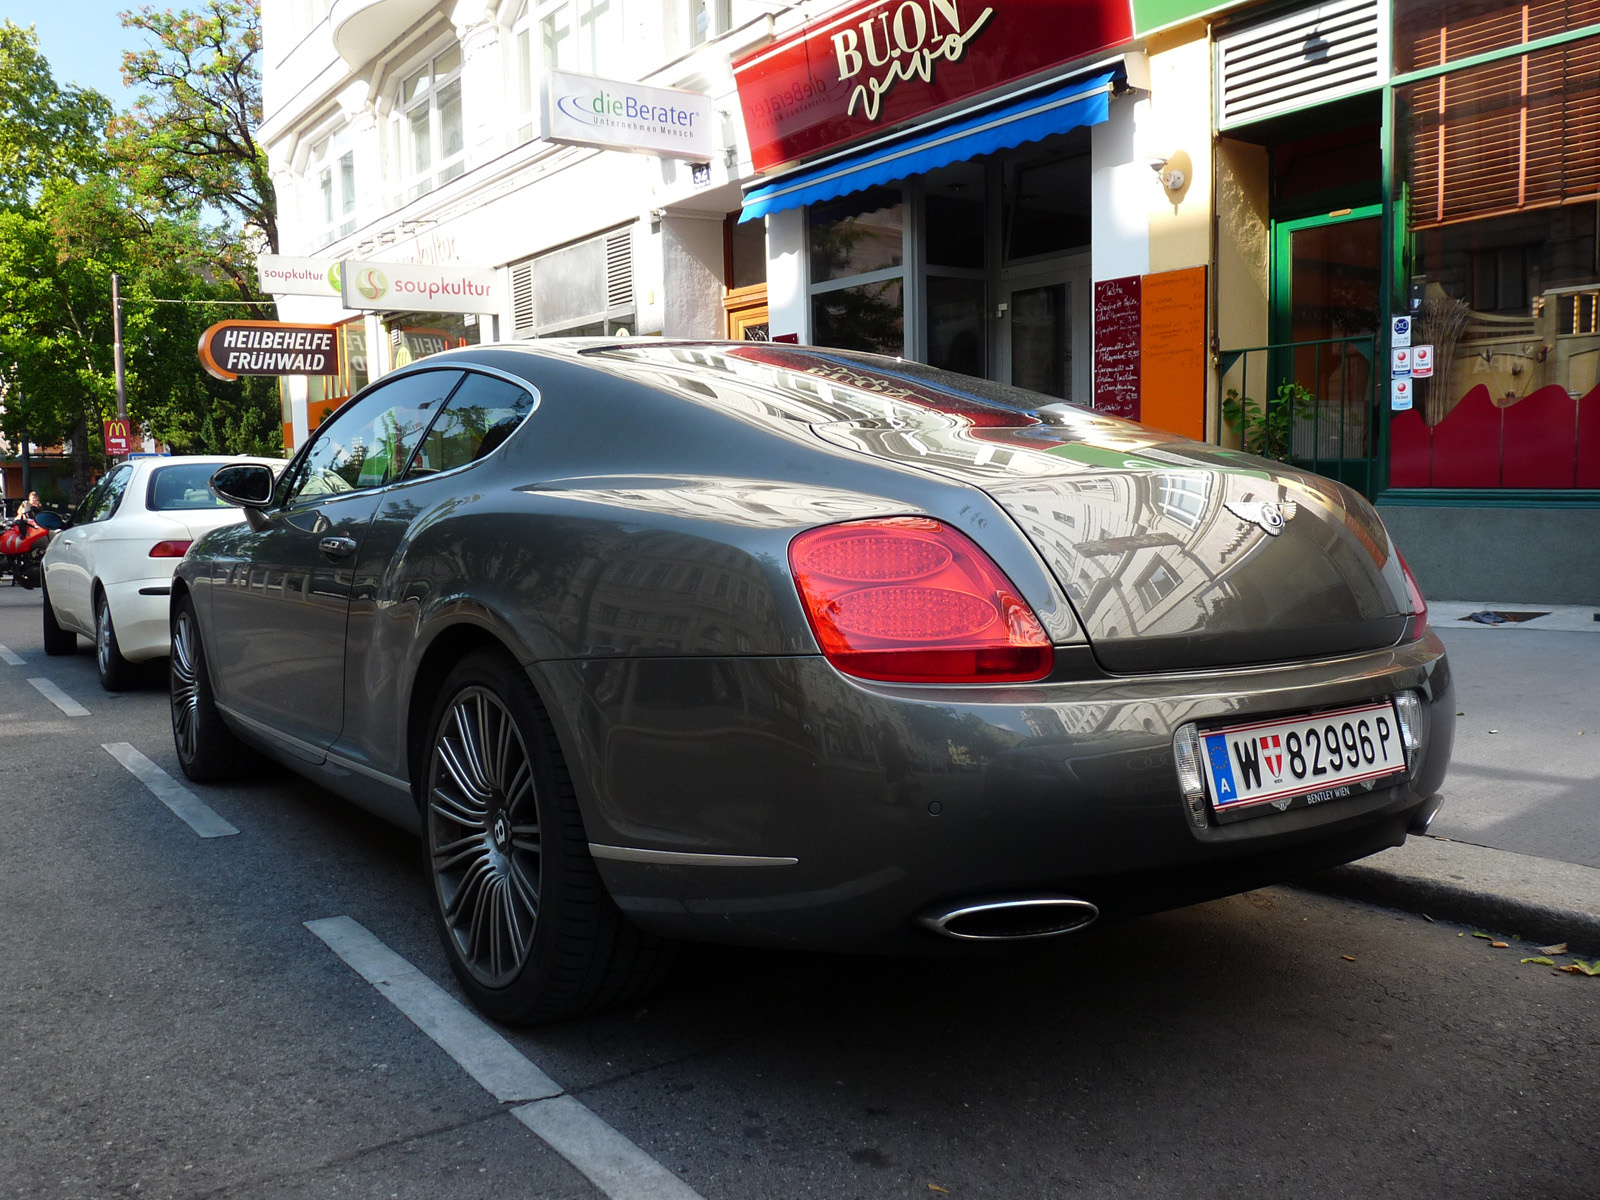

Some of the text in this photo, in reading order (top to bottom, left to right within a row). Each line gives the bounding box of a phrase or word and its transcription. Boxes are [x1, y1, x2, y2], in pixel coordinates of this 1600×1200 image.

[830, 0, 962, 81] BUON
[847, 7, 993, 121] vivo
[593, 115, 694, 138] Unternehmen Mensch
[264, 265, 324, 282] soupkultur
[394, 276, 491, 300] soupkultur
[223, 330, 333, 351] HEILBEHELFE
[227, 352, 325, 371] FRÜHWALD
[1233, 738, 1262, 790] W
[1220, 778, 1231, 794] A
[1306, 786, 1351, 805] BENTLEY WIEN
